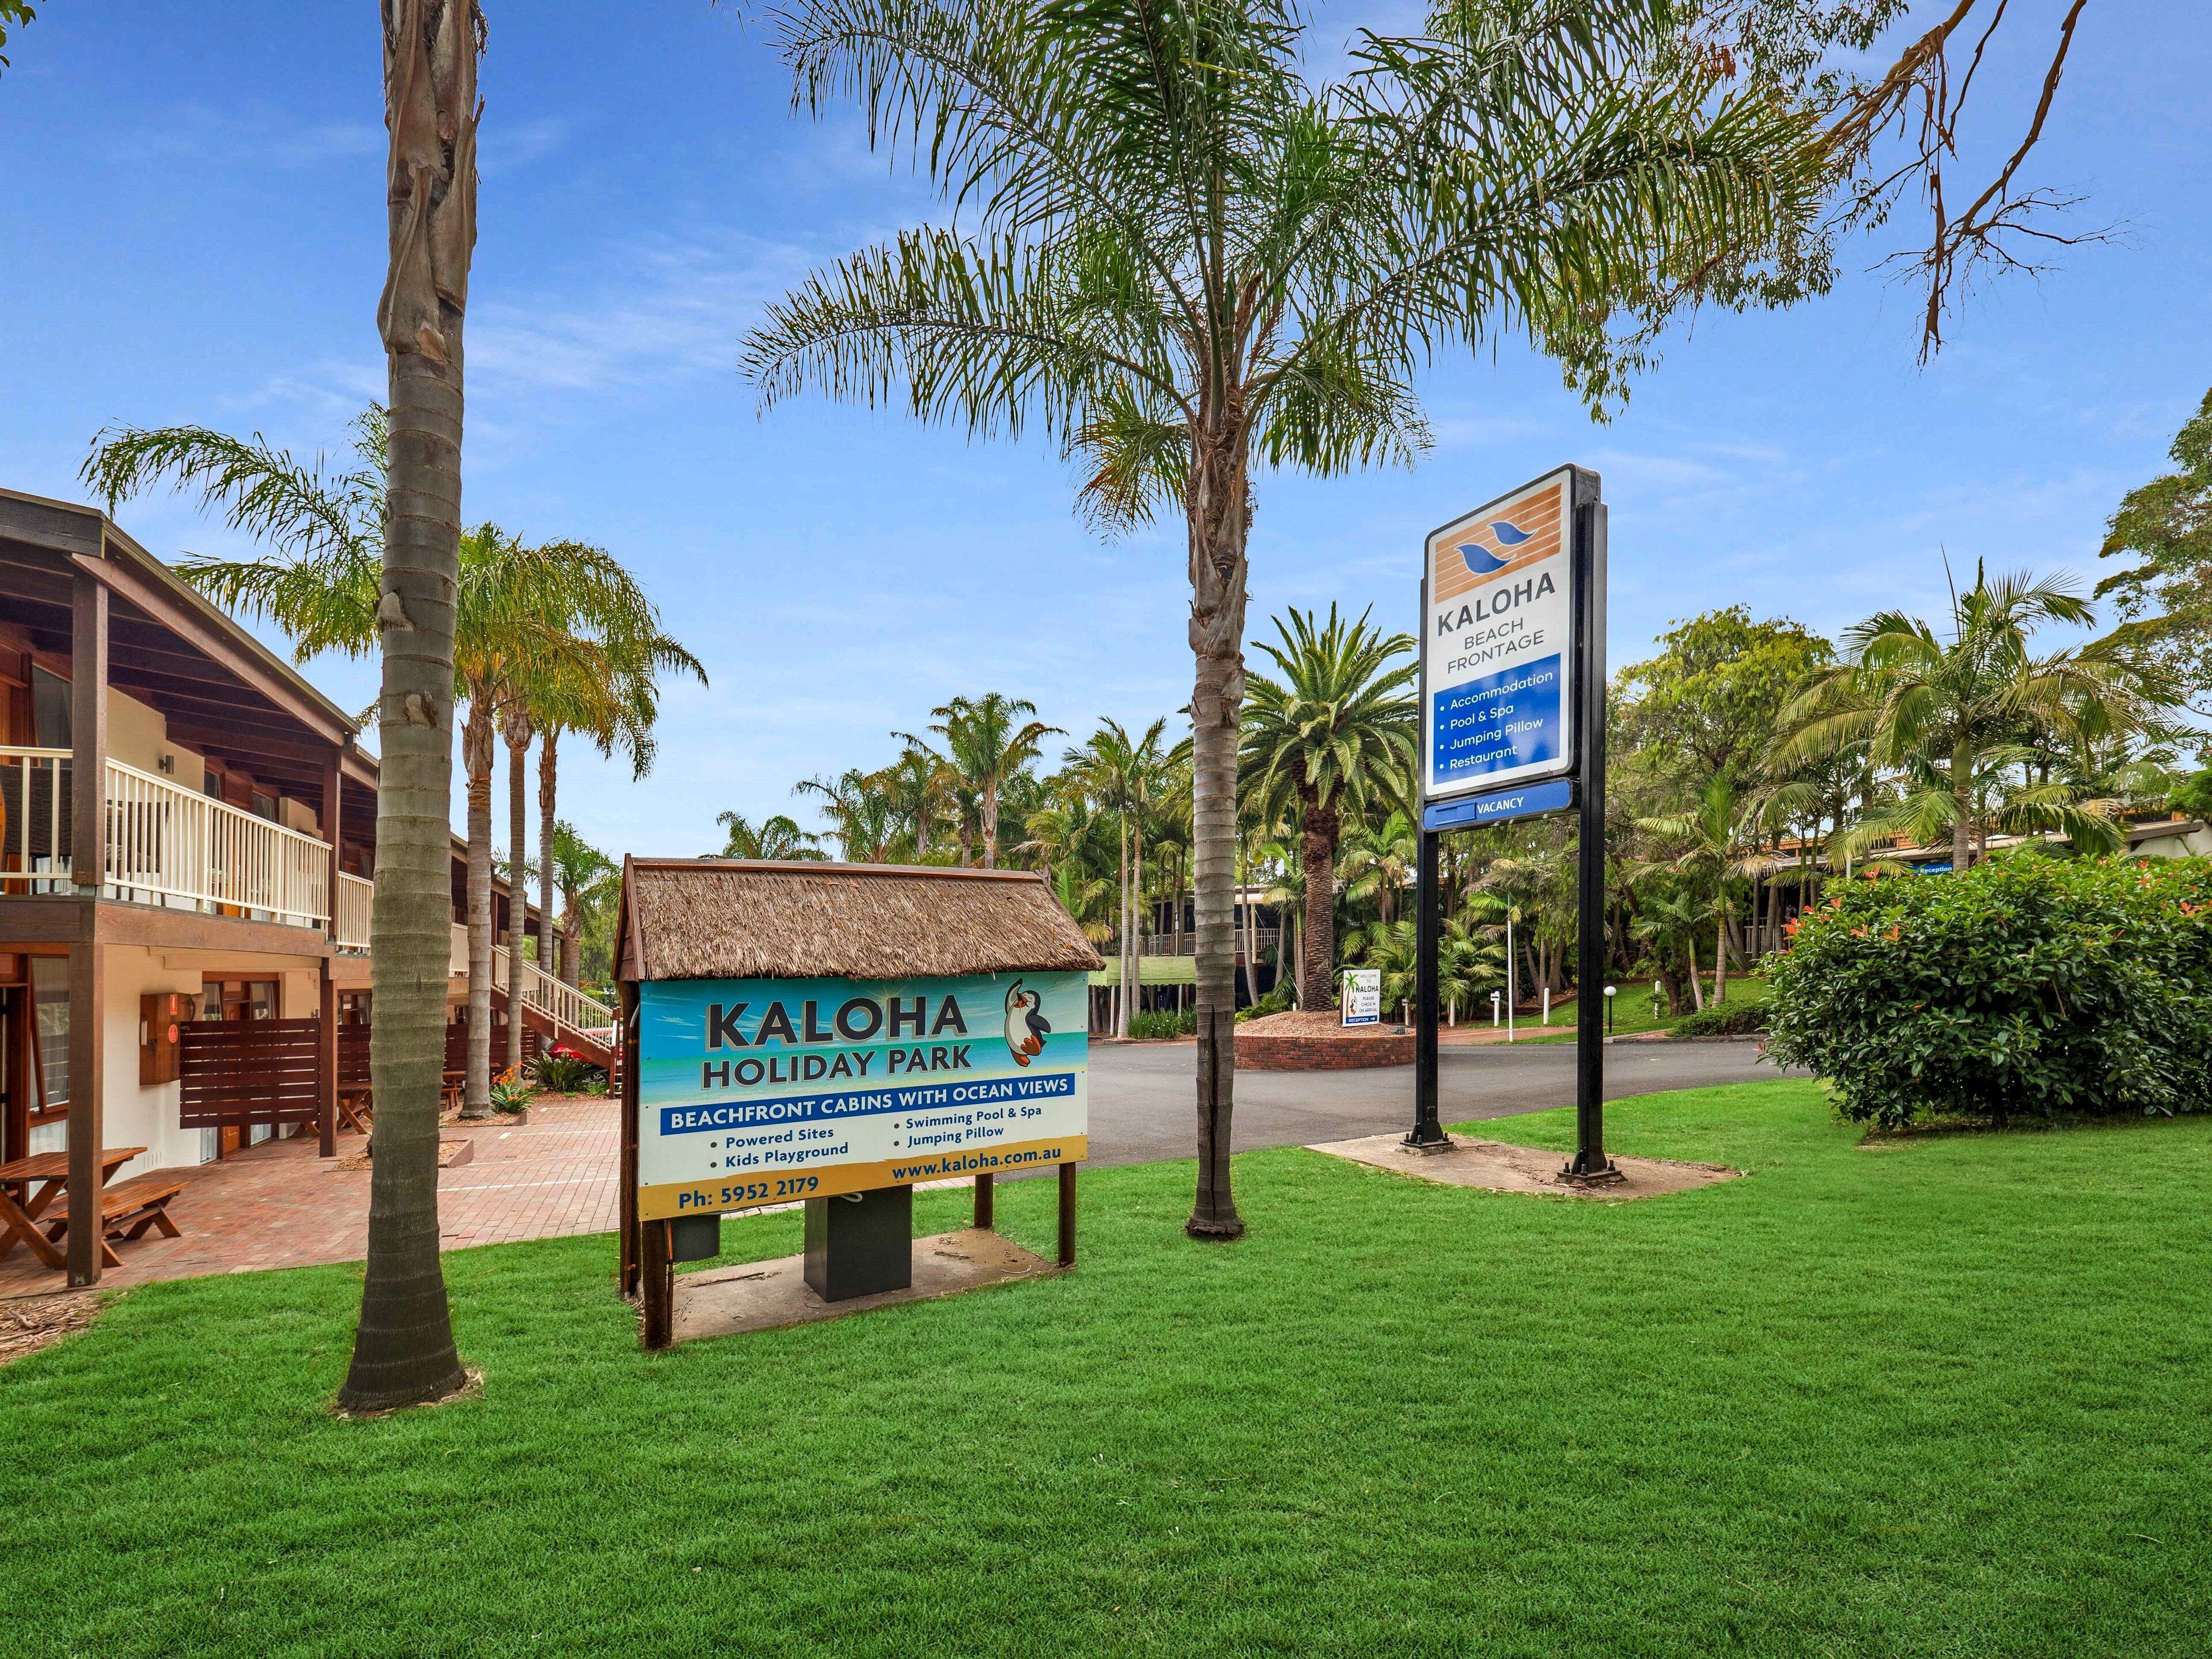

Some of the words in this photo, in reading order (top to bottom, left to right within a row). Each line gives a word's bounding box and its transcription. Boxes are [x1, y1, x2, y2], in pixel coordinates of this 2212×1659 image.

[1438, 572, 1555, 637] KALOHA
[1464, 617, 1523, 650] BEACH
[1448, 630, 1544, 674] FRONTAGE
[1450, 672, 1552, 710] Accommodation
[1450, 714, 1475, 730] Pool
[1478, 711, 1486, 722] &
[1490, 704, 1514, 719] Spa
[1450, 729, 1501, 749] Jumping
[1505, 718, 1543, 736] Pillow
[1450, 745, 1517, 770] Restaurant
[1477, 797, 1524, 814] VACANCY
[706, 994, 968, 1051] KALOHA
[702, 1051, 876, 1089] HOLIDAY
[888, 1044, 972, 1075] PARK
[671, 1101, 816, 1129] BEACHFRONT
[821, 1094, 892, 1113] CABINS
[898, 1089, 947, 1107] WITH
[953, 1082, 1013, 1101] OCEAN
[1017, 1078, 1068, 1094] VIEWS
[906, 1113, 972, 1129] Swimming
[976, 1108, 1003, 1121] Pool
[1007, 1108, 1016, 1118] &
[1020, 1106, 1041, 1118] Spa
[726, 1130, 793, 1149] Powered
[798, 1128, 834, 1141] Sites
[907, 1132, 962, 1148] Jumping
[965, 1127, 1003, 1140] Pillow
[726, 1153, 759, 1168] Kids
[764, 1142, 849, 1164] Playground
[892, 1147, 1062, 1179] www.kaloha.com.au
[679, 1190, 713, 1209] Ph:
[721, 1183, 768, 1203] 5952
[776, 1176, 819, 1196] 2179
